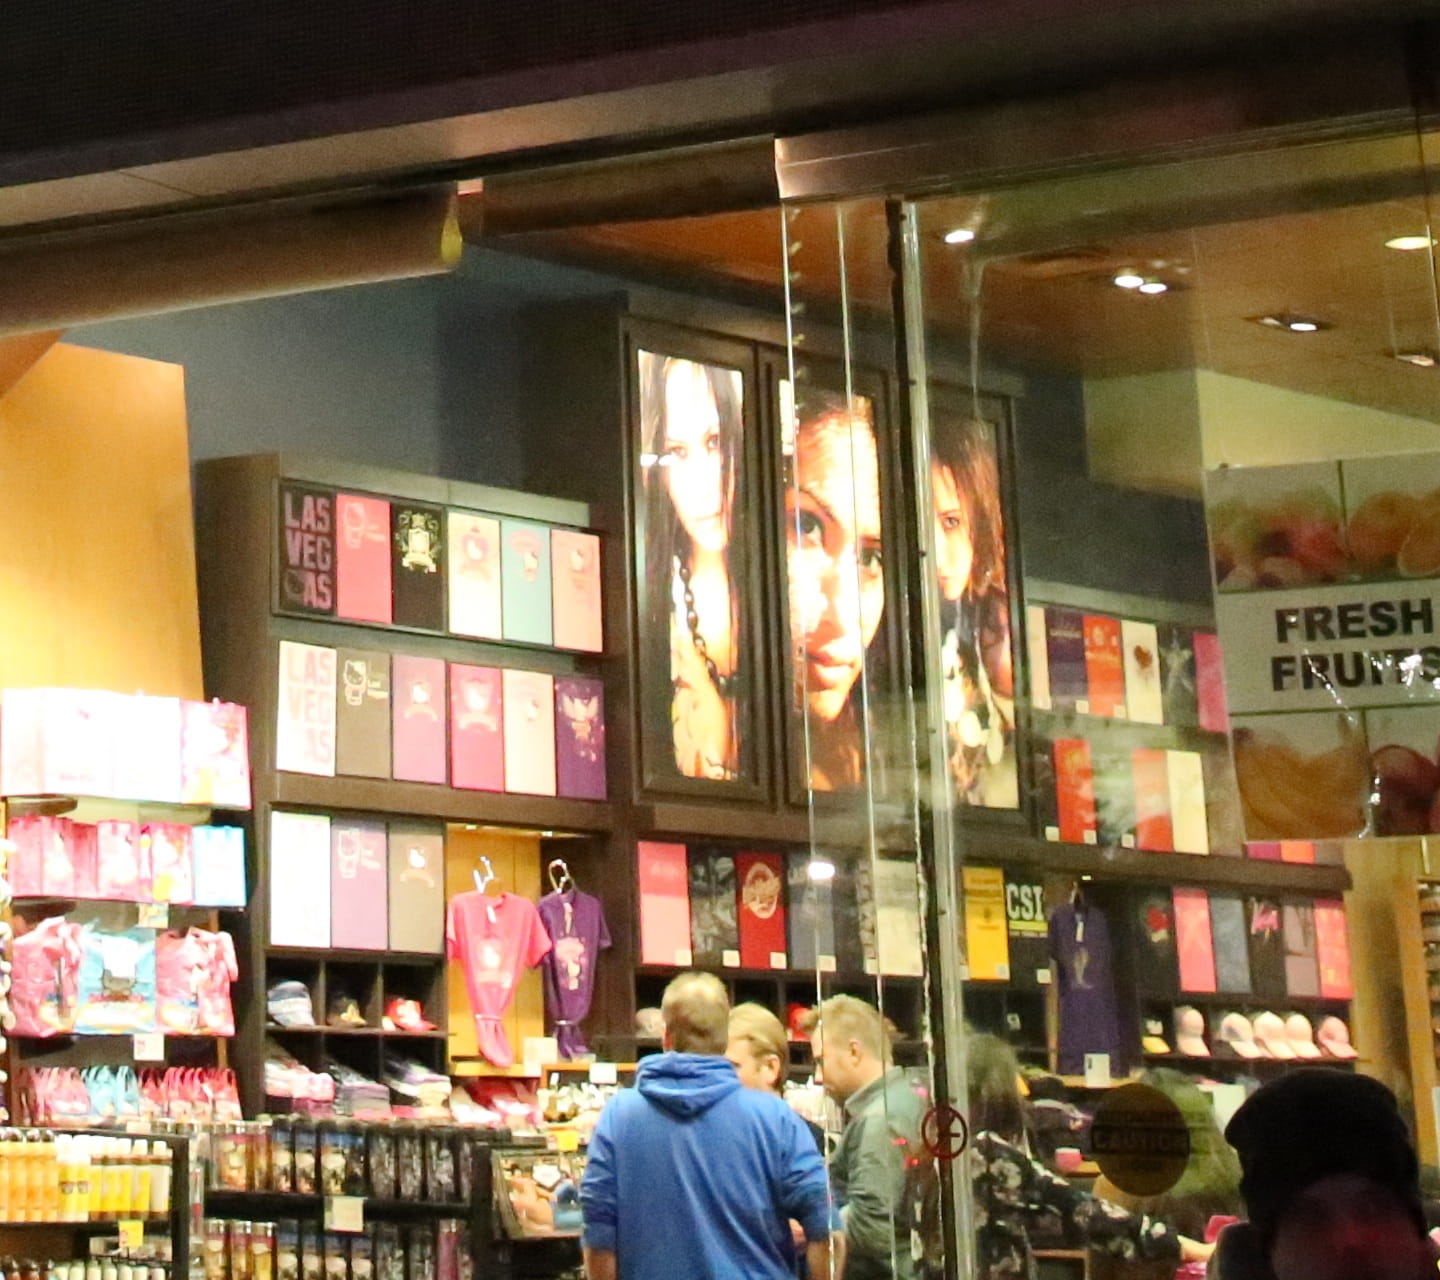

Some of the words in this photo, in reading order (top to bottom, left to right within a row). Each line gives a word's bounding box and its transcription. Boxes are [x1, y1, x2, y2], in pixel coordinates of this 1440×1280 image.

[283, 491, 331, 533] LAS
[286, 529, 333, 572] VEG
[1275, 598, 1434, 643] FRESH
[1006, 883, 1045, 920] CSI
